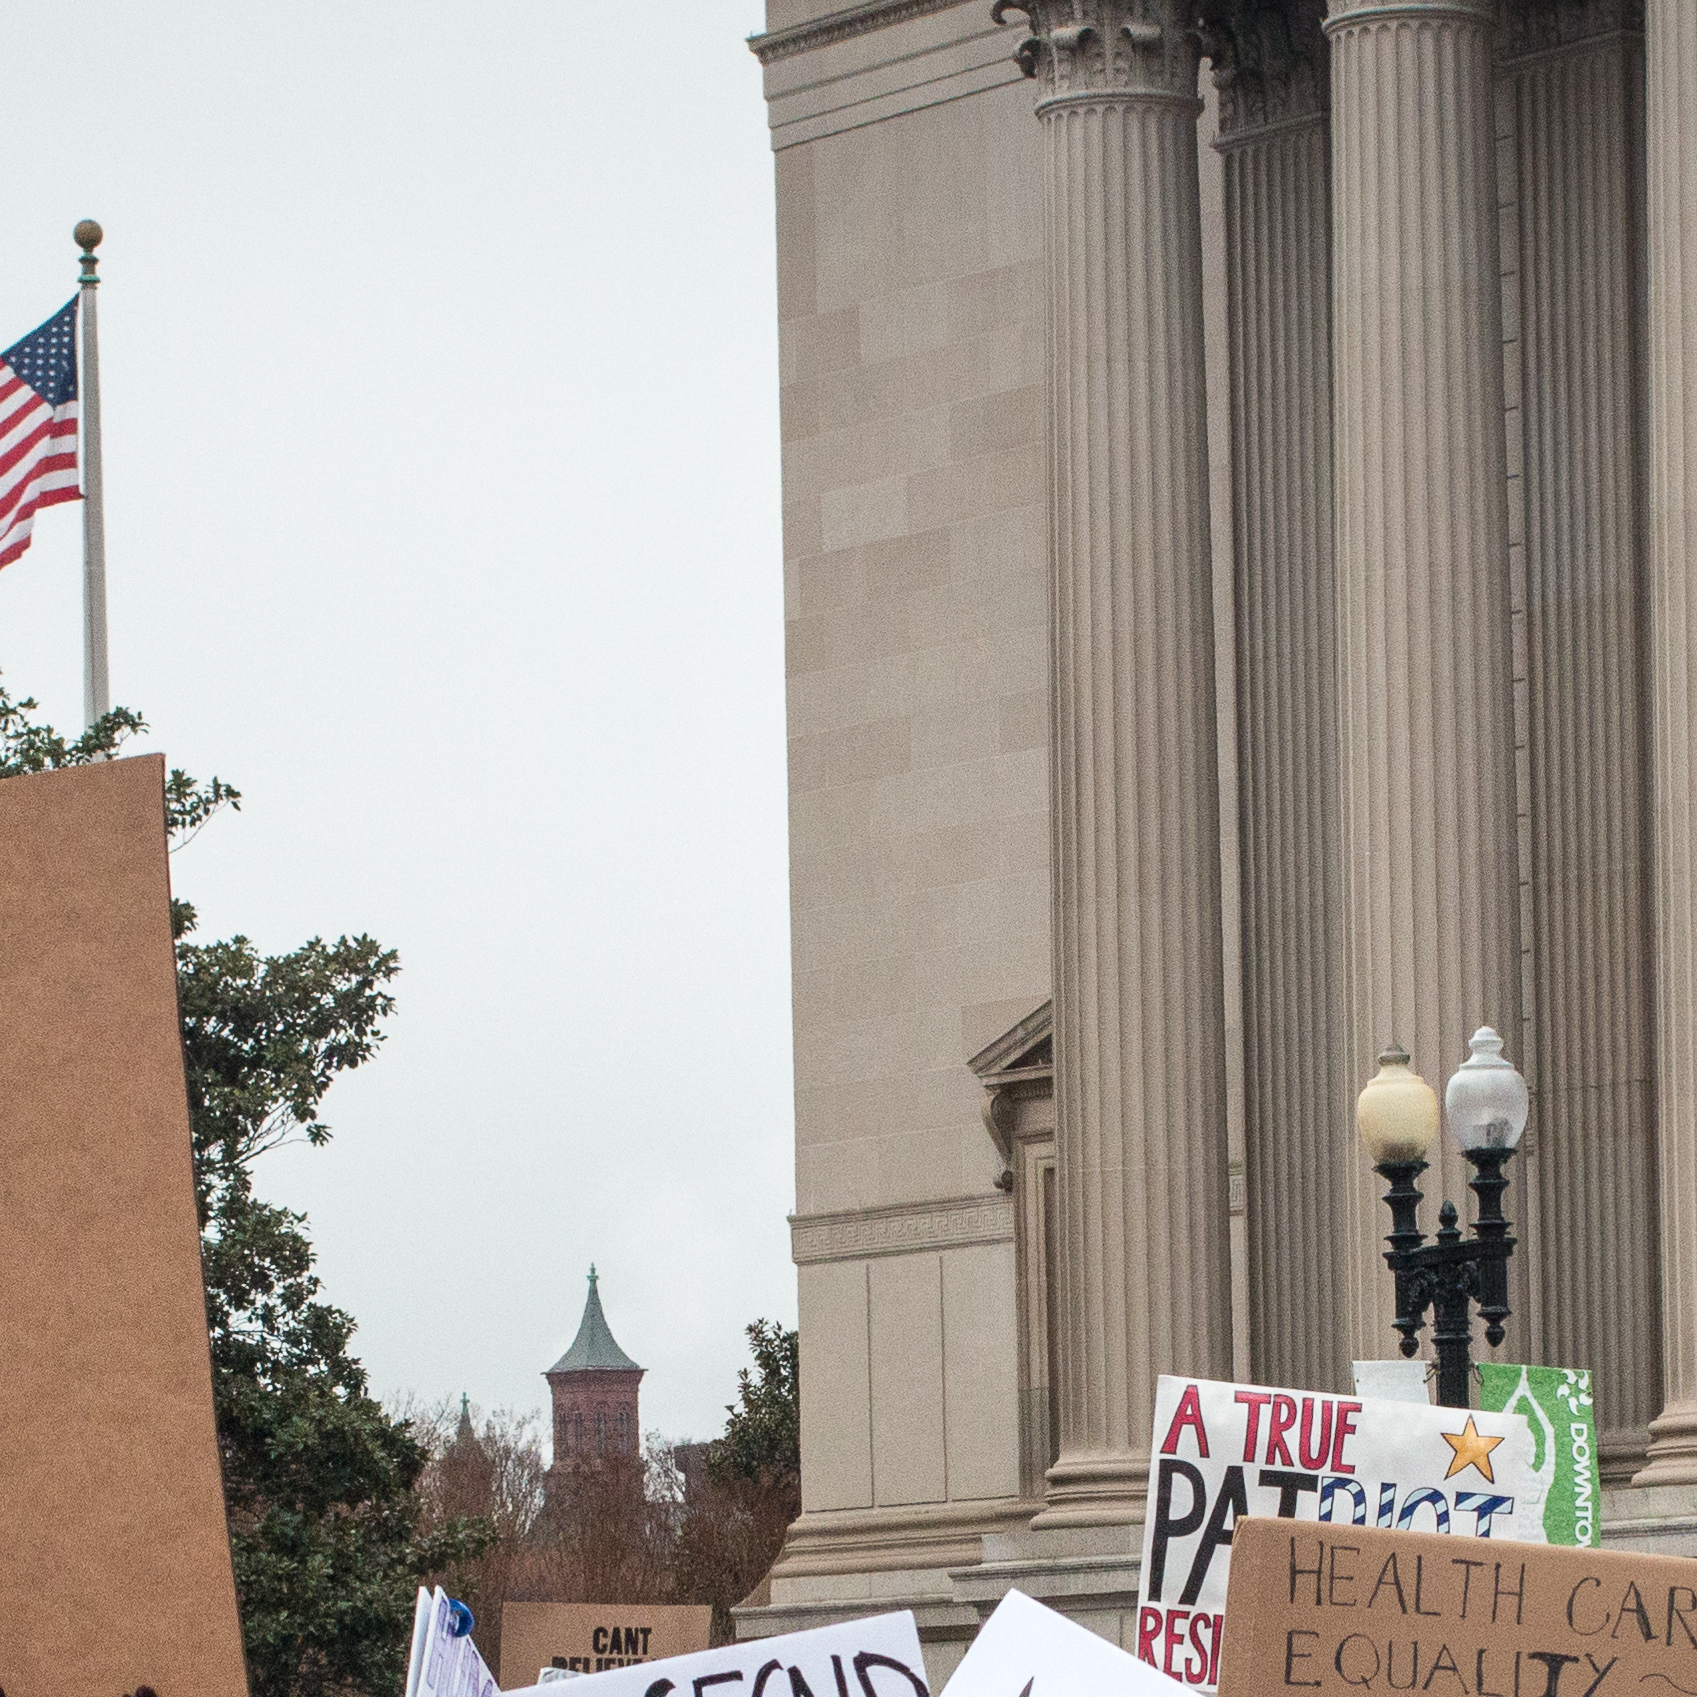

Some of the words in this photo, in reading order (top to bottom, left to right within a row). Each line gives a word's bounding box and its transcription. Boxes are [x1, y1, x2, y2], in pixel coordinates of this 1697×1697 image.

[1160, 1385, 1210, 1458] A
[1234, 1390, 1362, 1475] TRUE
[1569, 1423, 1594, 1548] DOWNTO
[1290, 1537, 1526, 1625] HEALTH
[593, 1627, 652, 1655] CANT
